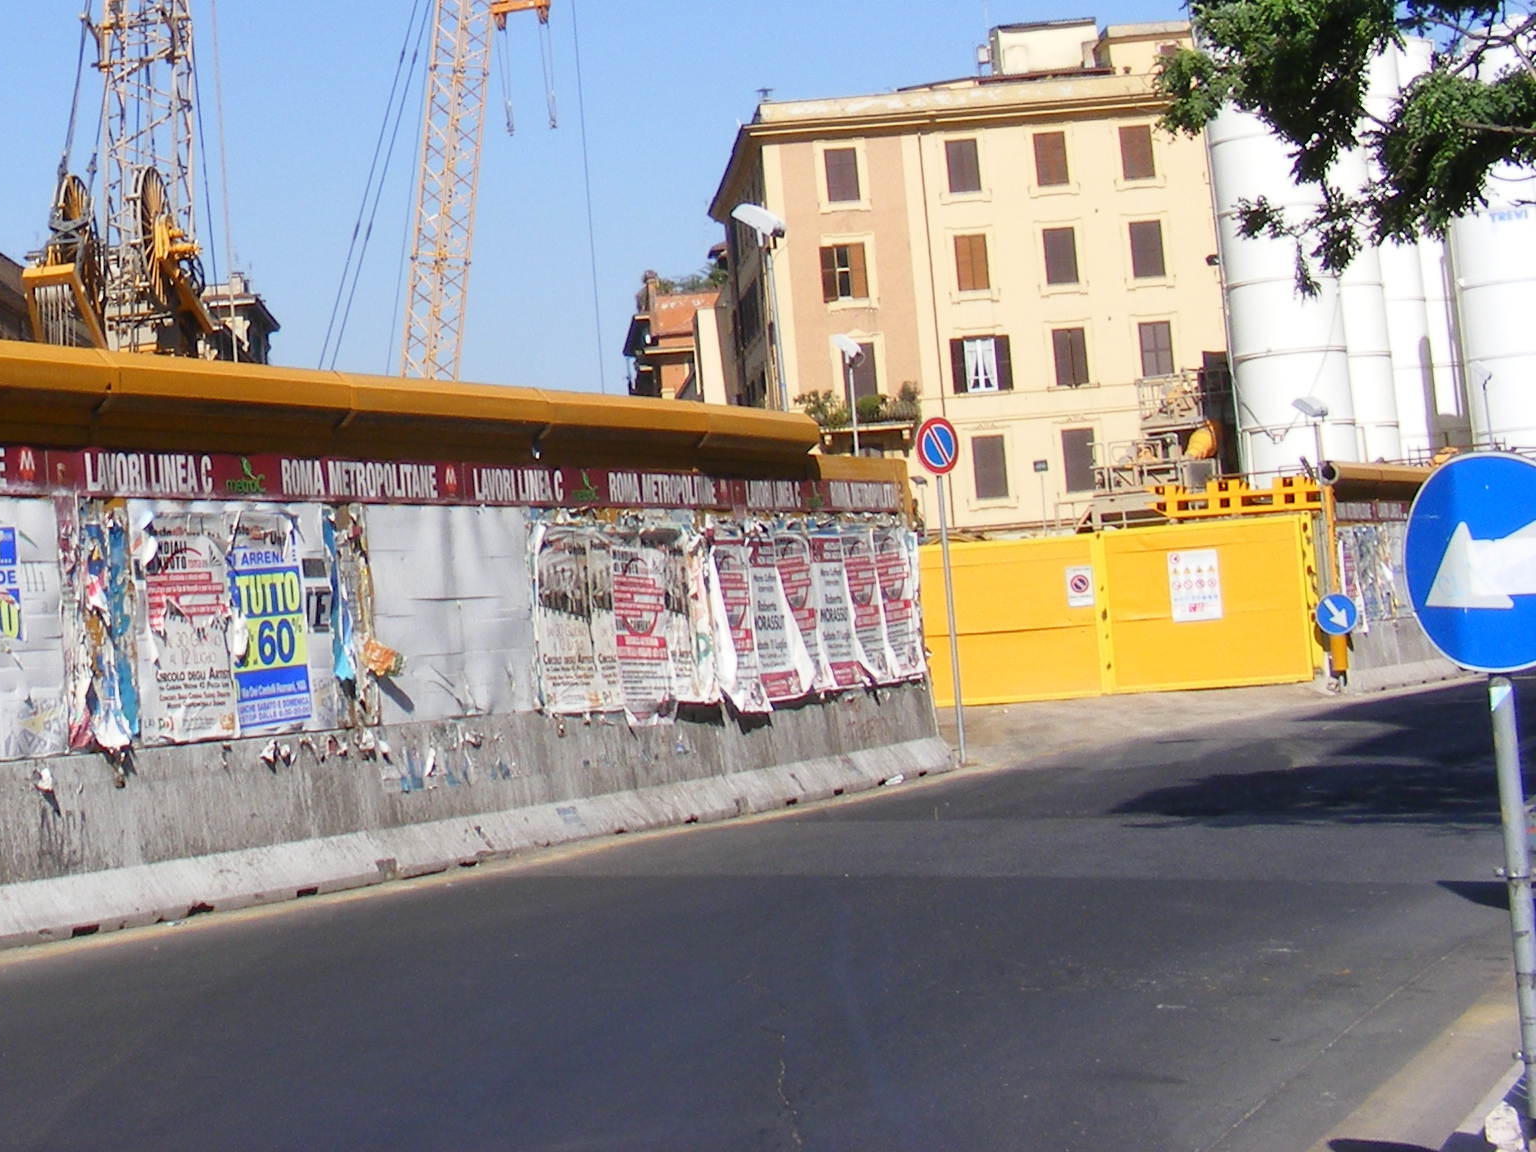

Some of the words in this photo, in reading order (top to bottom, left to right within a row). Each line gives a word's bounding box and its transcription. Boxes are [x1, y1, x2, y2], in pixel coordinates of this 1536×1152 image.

[83, 451, 147, 492] LAVORI
[151, 453, 199, 493] LINEA
[200, 455, 213, 494] C
[280, 458, 326, 496] ROMA
[327, 460, 439, 499] METROPOLITANE
[472, 468, 515, 501] LAVORI
[517, 470, 553, 502] LINEA
[553, 470, 564, 502] C
[608, 472, 642, 504] ROMA
[642, 474, 718, 506] METROPOLITANE
[235, 571, 301, 616] TUTTO
